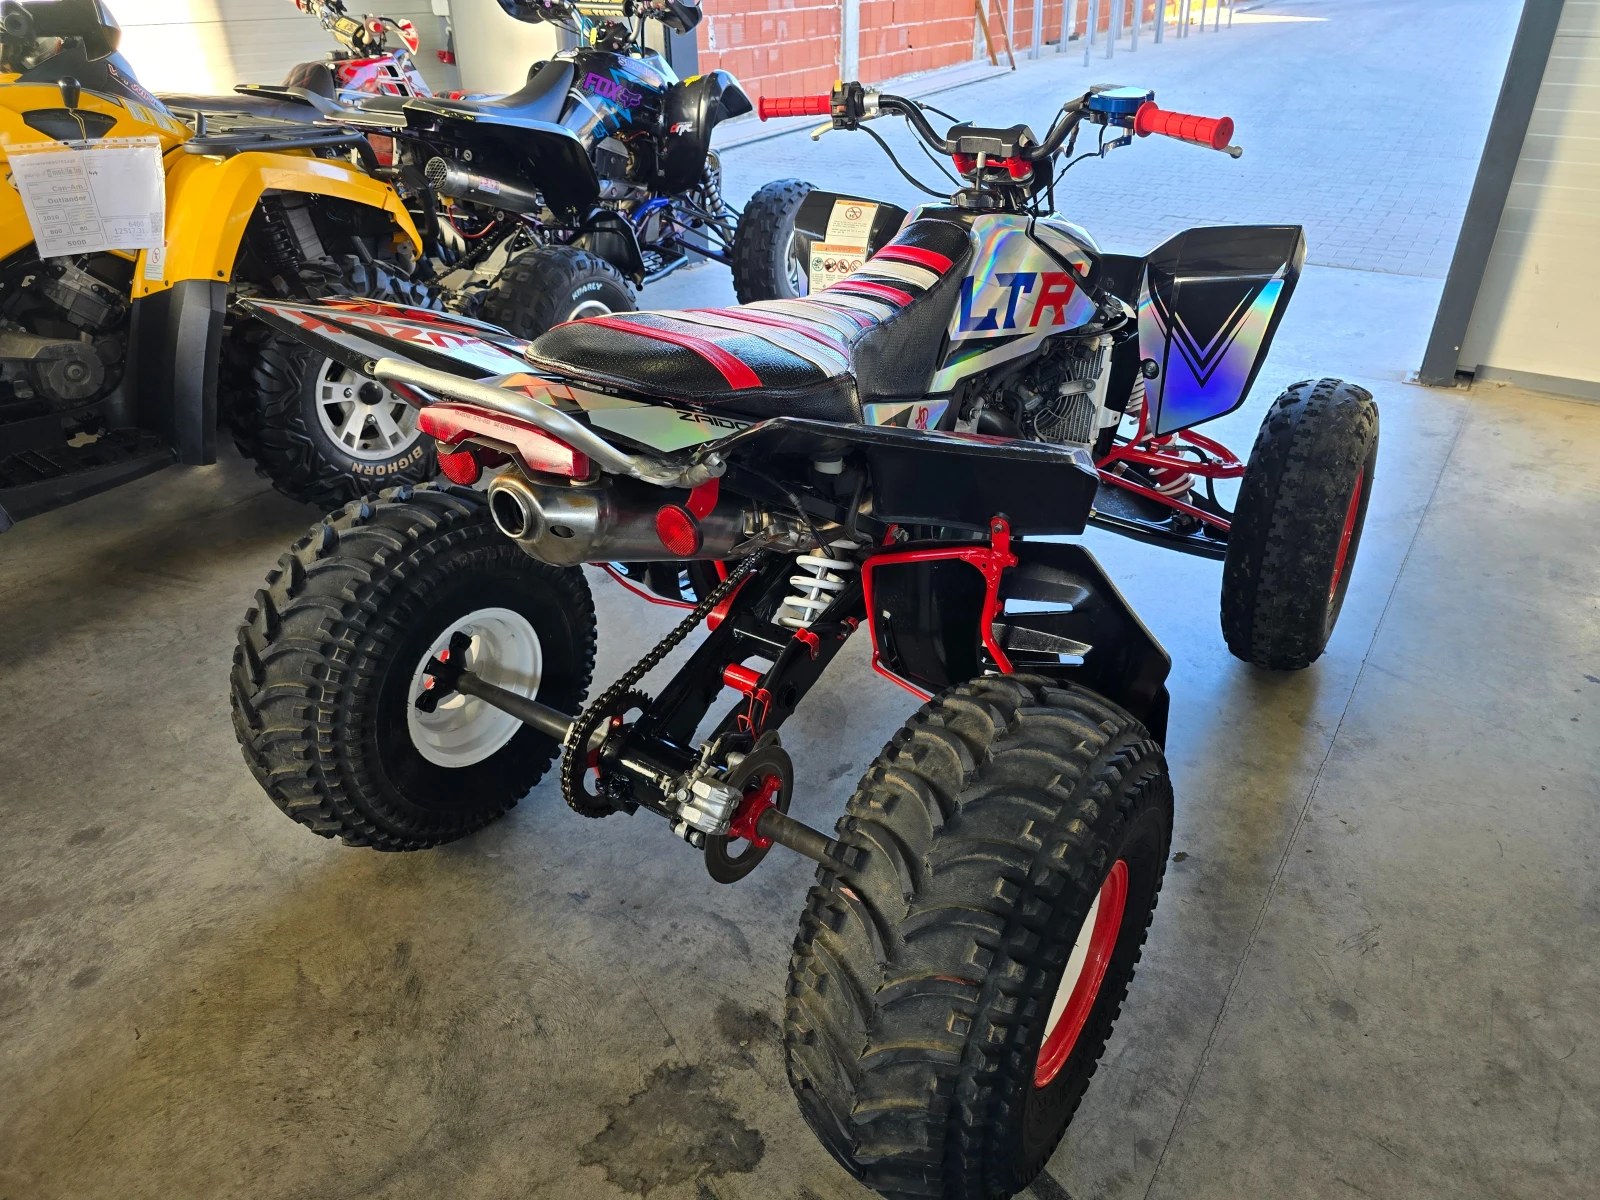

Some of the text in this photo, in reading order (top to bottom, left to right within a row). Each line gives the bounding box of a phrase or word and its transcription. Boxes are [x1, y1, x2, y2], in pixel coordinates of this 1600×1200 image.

[583, 72, 622, 101] FOX
[47, 195, 86, 204] Outlander
[52, 184, 83, 192] Can-Am
[958, 264, 1083, 333] LTR
[351, 445, 424, 476] BIGHORN
